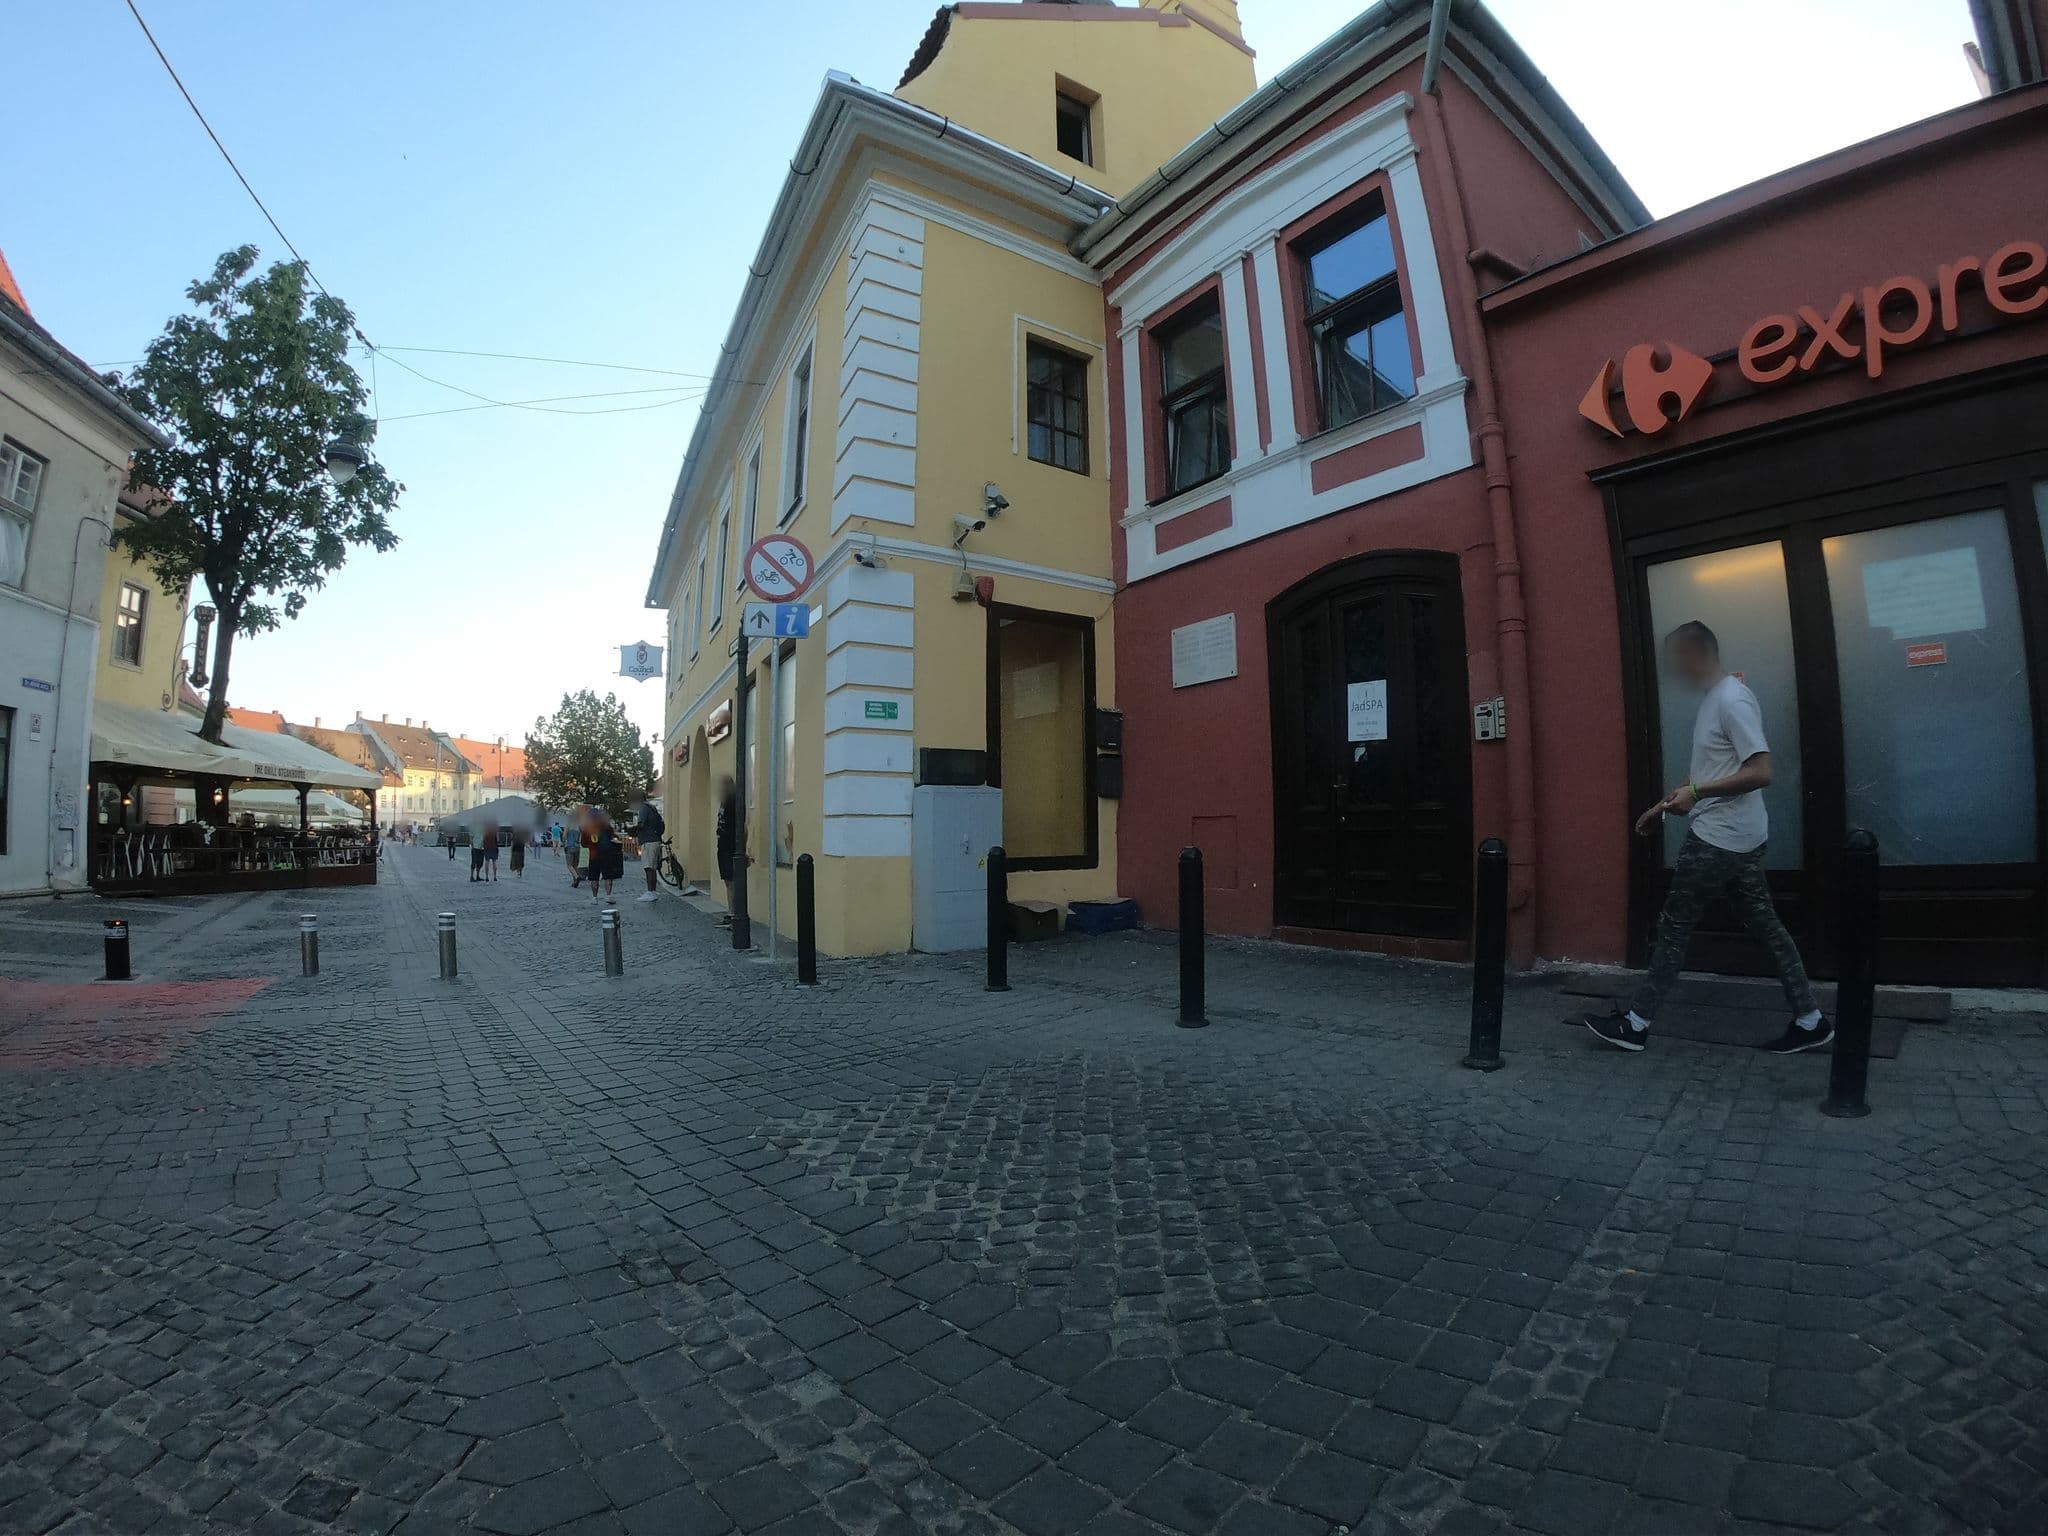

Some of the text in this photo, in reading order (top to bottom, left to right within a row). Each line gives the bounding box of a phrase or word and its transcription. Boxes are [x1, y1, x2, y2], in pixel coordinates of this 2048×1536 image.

[1738, 241, 2048, 383] expre
[786, 606, 798, 635] i
[628, 665, 654, 673] Council
[1351, 699, 1384, 712] JadSPA
